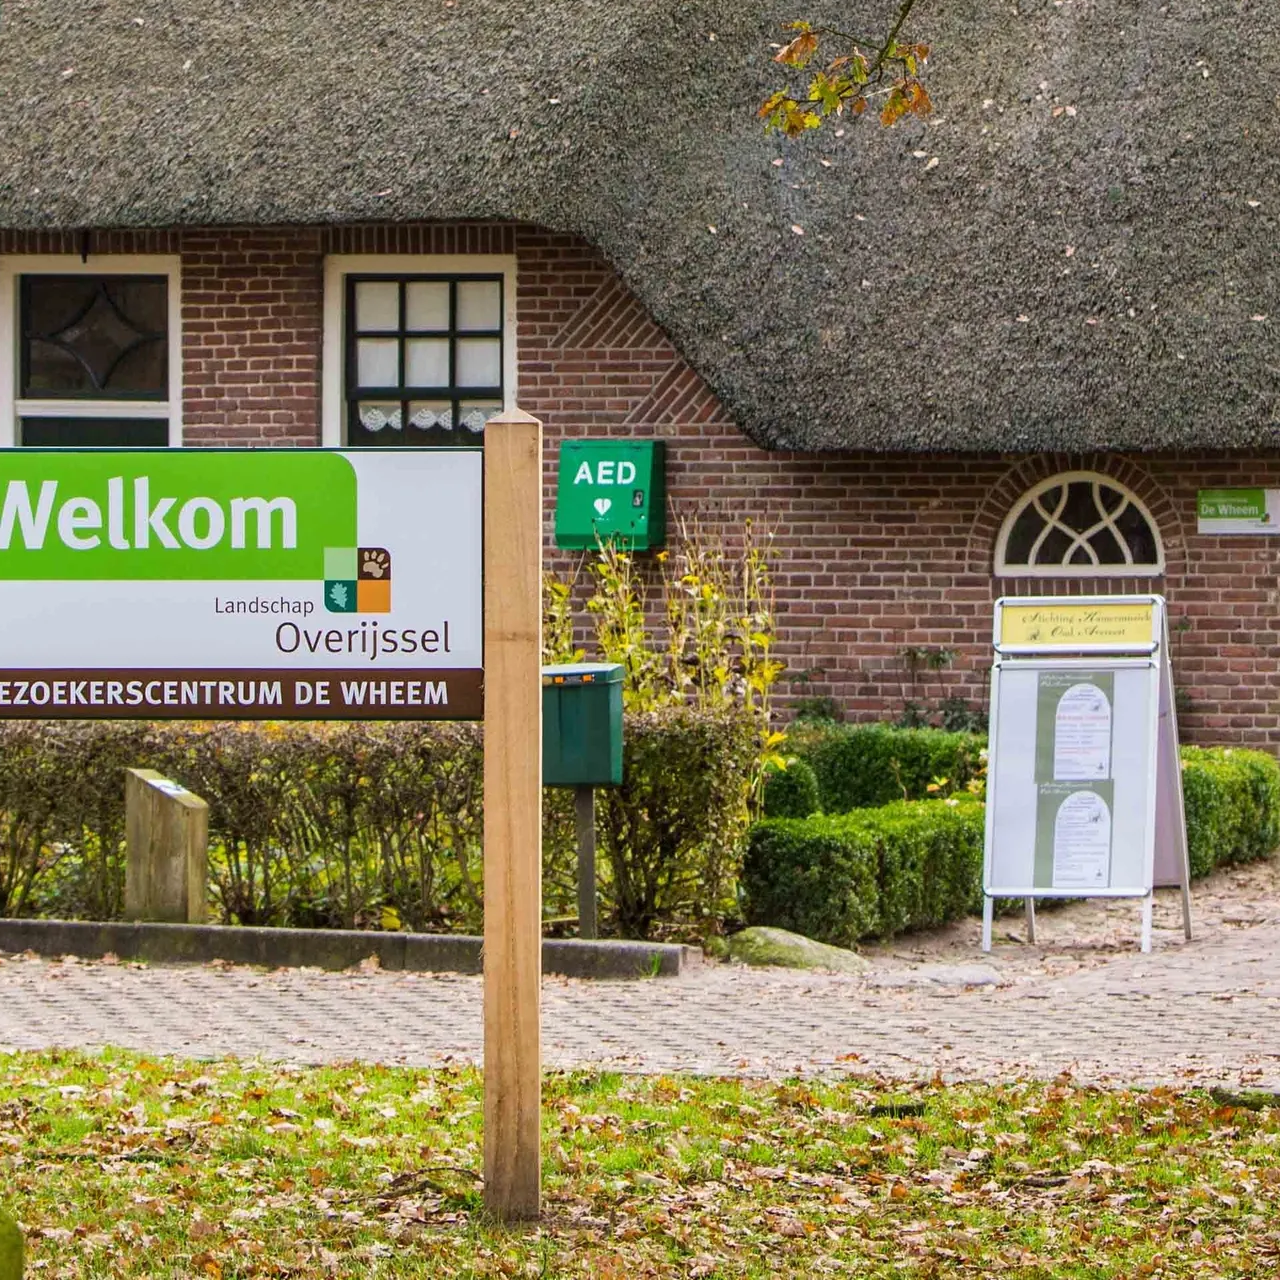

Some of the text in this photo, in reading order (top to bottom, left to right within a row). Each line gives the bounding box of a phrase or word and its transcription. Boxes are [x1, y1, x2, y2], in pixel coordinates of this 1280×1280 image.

[573, 461, 637, 485] AED
[1200, 503, 1259, 516] De Wheem
[215, 596, 314, 616] Landschap
[275, 622, 451, 660] Overijssel
[295, 681, 330, 705] DE
[340, 681, 448, 705] WHEEM
